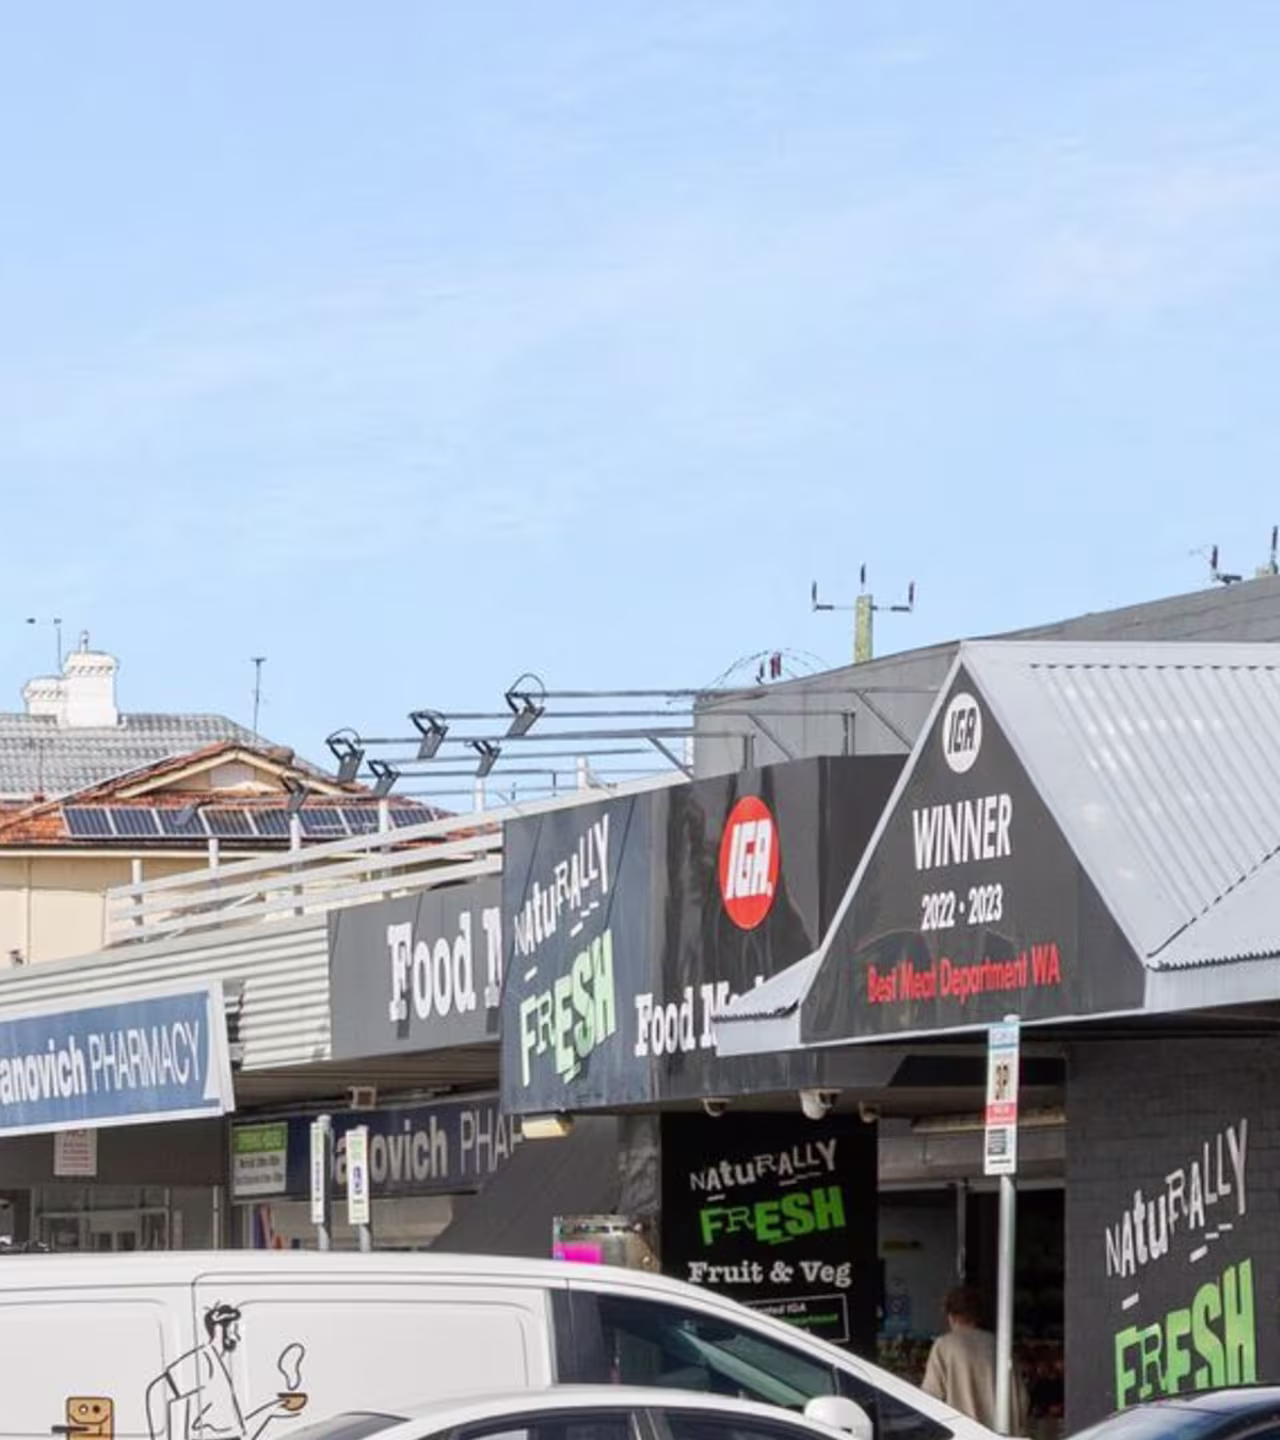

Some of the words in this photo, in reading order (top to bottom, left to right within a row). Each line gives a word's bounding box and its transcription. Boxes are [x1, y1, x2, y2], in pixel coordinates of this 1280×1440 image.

[947, 706, 977, 755] IGA
[724, 818, 774, 901] IGA
[912, 792, 1013, 871] WINNER
[920, 890, 957, 932] 2022
[967, 883, 1004, 925] 2023
[387, 914, 477, 1022] Food
[867, 966, 896, 1004] Best
[899, 959, 937, 1001] Meat
[940, 952, 1027, 1005] Department
[1031, 943, 1061, 985] WA
[520, 928, 617, 1087] FRESH
[635, 986, 695, 1057] Food
[88, 1019, 200, 1094] PHARMACY
[699, 1185, 847, 1246] FRESH
[687, 1260, 764, 1284] Fruit
[769, 1260, 795, 1284] &
[798, 1260, 853, 1288] Veg
[1114, 1257, 1257, 1412] FRESH
